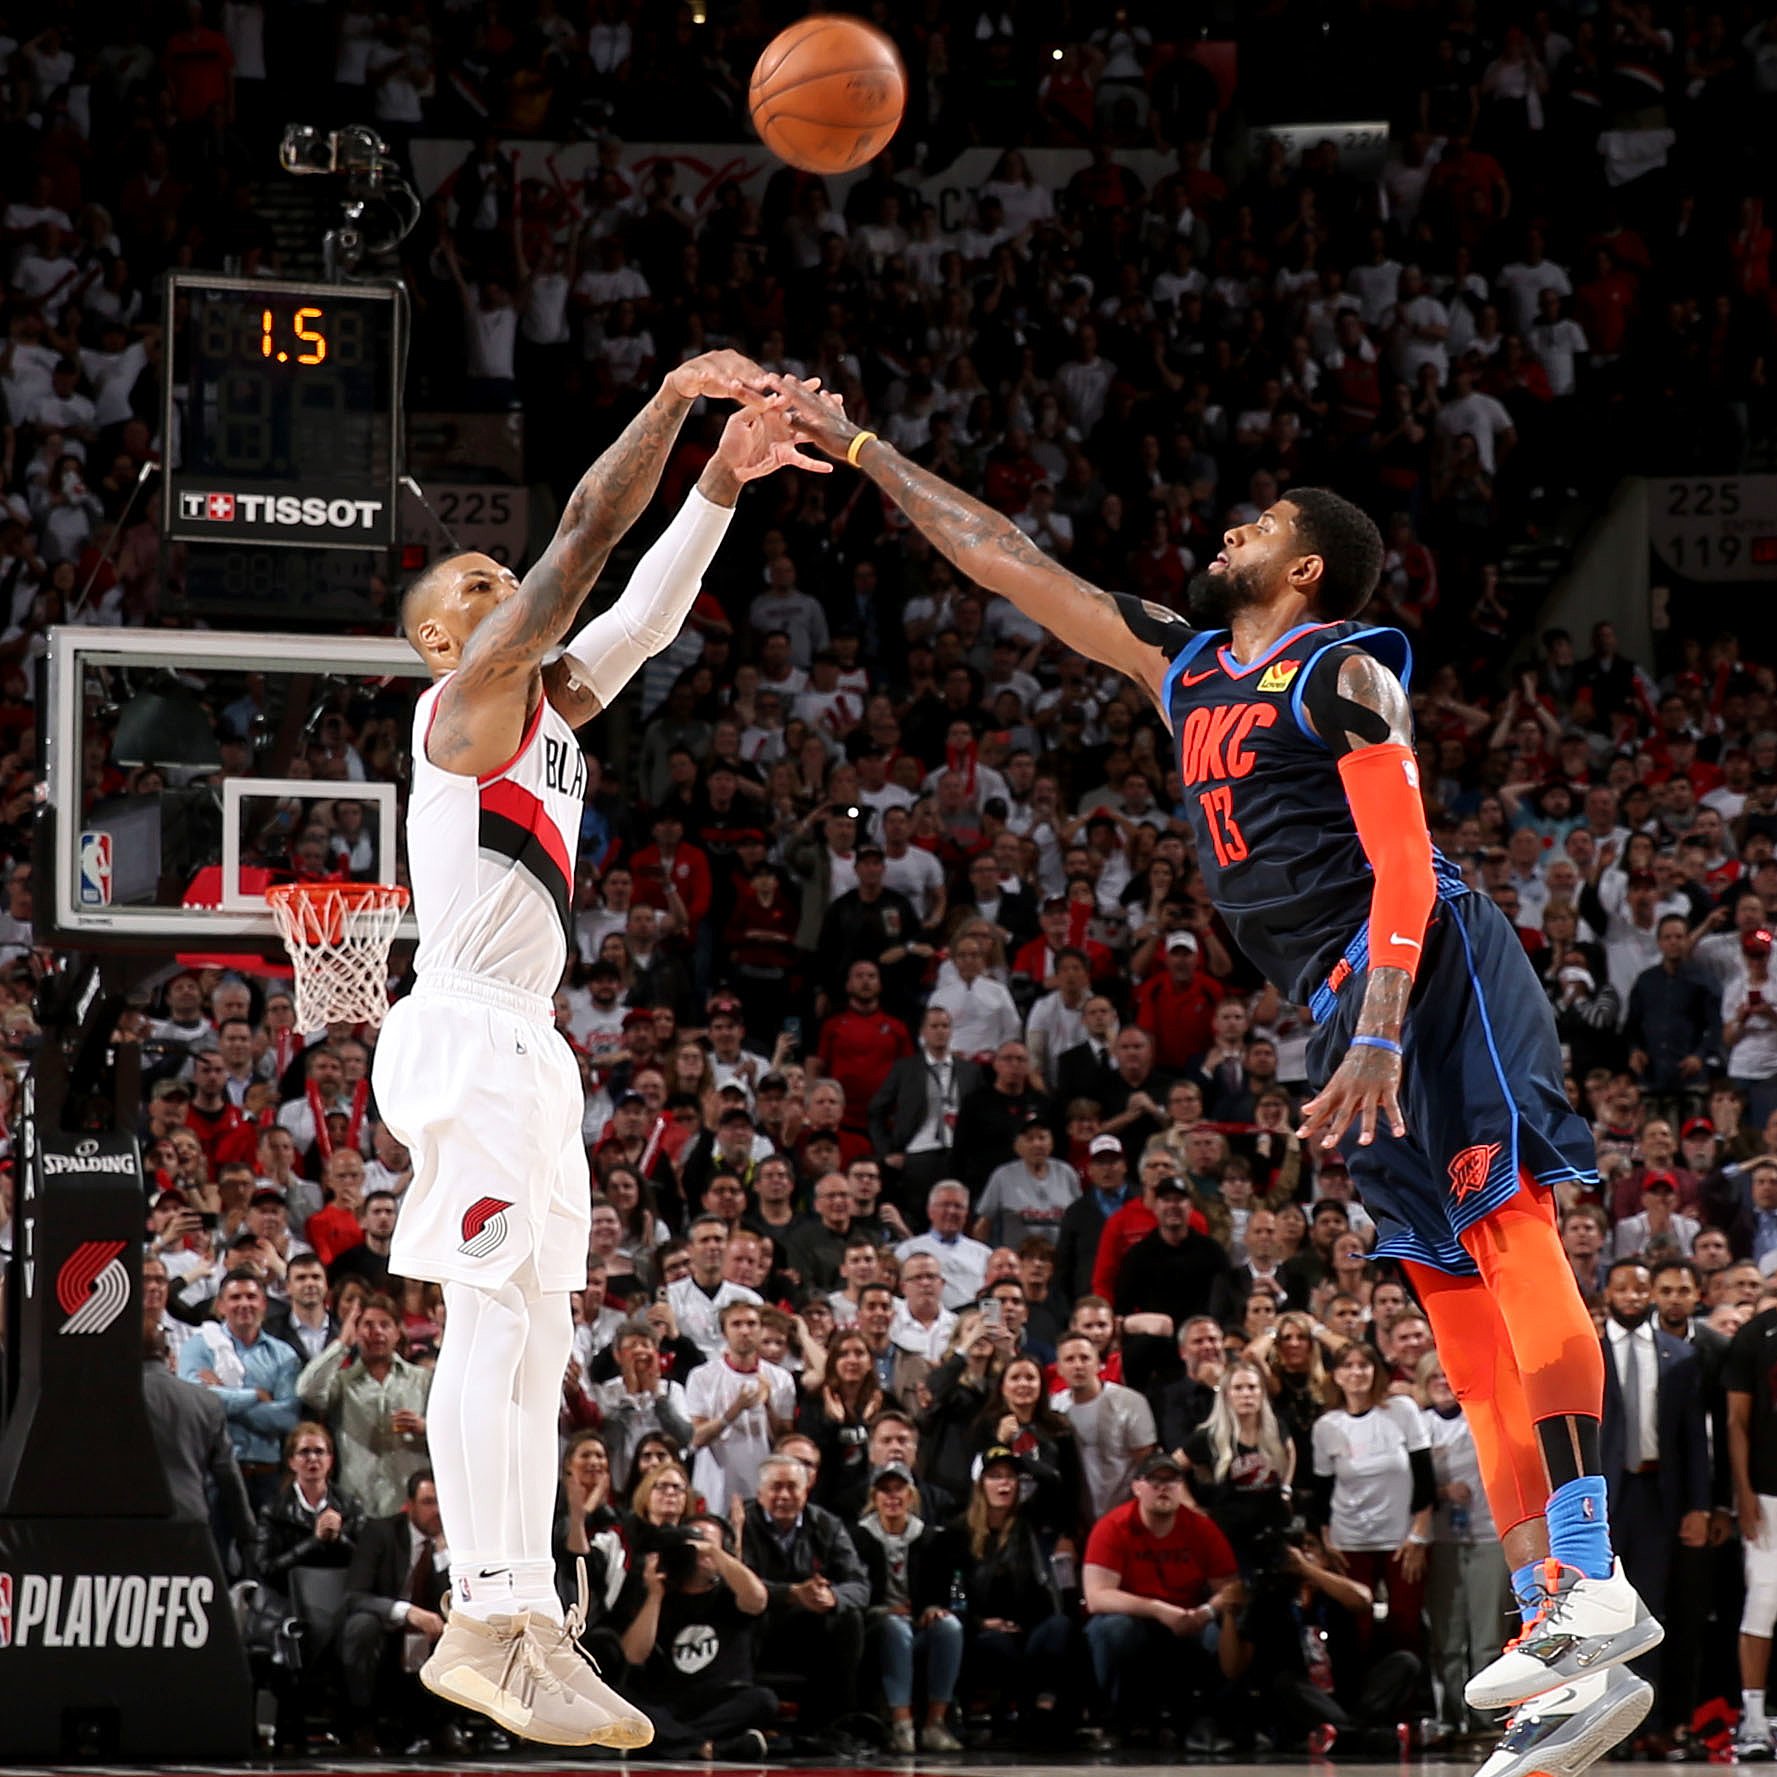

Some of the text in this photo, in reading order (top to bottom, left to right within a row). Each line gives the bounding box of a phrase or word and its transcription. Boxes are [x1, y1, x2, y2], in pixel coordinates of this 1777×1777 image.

[260, 306, 328, 365] 1.5
[235, 494, 383, 529] TISSOT
[439, 493, 508, 524] 225
[1669, 483, 1740, 515] 225
[1670, 536, 1740, 567] 119
[1182, 702, 1279, 786] OKC
[1199, 785, 1249, 868] 13
[42, 1152, 136, 1175] SPALDING
[23, 1217, 36, 1299] TV
[15, 1574, 215, 1649] PLAYOFFS
[673, 1636, 718, 1661] TNT
